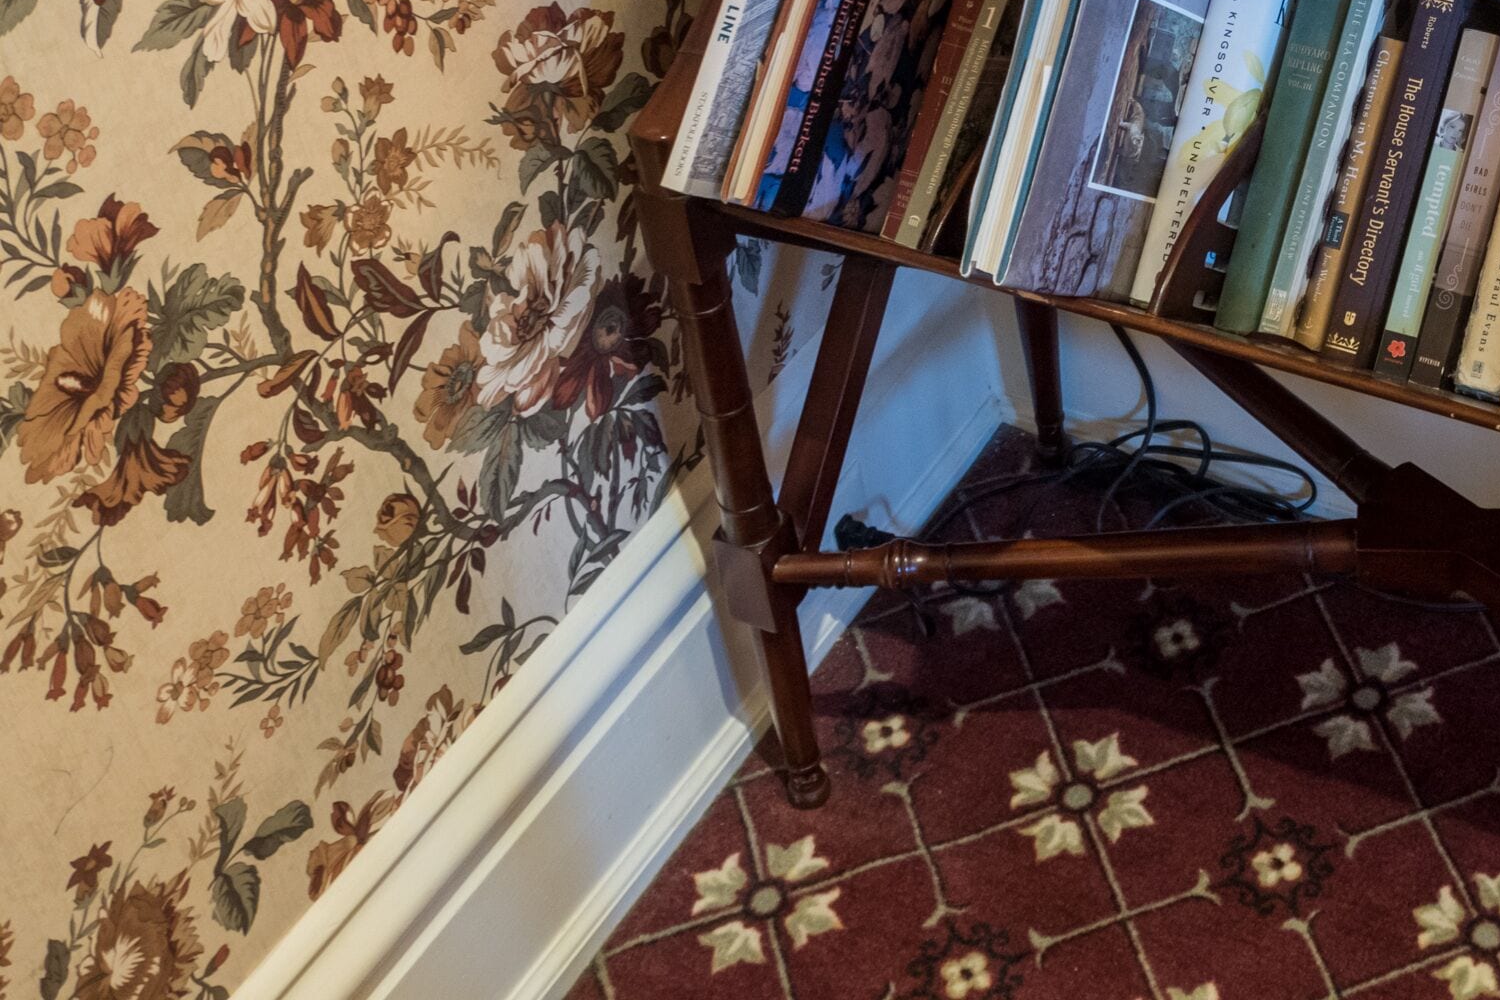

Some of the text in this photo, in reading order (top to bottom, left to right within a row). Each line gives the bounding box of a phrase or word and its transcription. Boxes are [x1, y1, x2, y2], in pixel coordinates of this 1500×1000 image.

[717, 5, 740, 44] LINE
[842, 0, 865, 48] Frost
[981, 6, 997, 30] 1
[1421, 16, 1437, 49] Roberts
[971, 39, 990, 76] Michael
[1202, 10, 1238, 117] KINGSOLVER
[1287, 56, 1324, 74] KIPLING
[1317, 0, 1366, 149] THE TEA COMPANION
[963, 76, 977, 93] Van
[674, 90, 708, 177] STACKPOLE BOOKS
[788, 101, 820, 174] Burkett
[943, 95, 969, 149] Valkenburgh
[1338, 50, 1391, 206] Christmas in My Heart
[926, 153, 948, 195] Associates
[1350, 77, 1424, 287] The House Servant's Directory
[1464, 182, 1488, 197] GIRLS
[1473, 165, 1489, 178] BAD
[1162, 141, 1202, 263] UNSHELTERED
[1421, 164, 1451, 239] tempted
[1287, 209, 1308, 259] PETTIGREW
[1478, 313, 1497, 353] Evans
[1418, 356, 1441, 368] HYPERION
